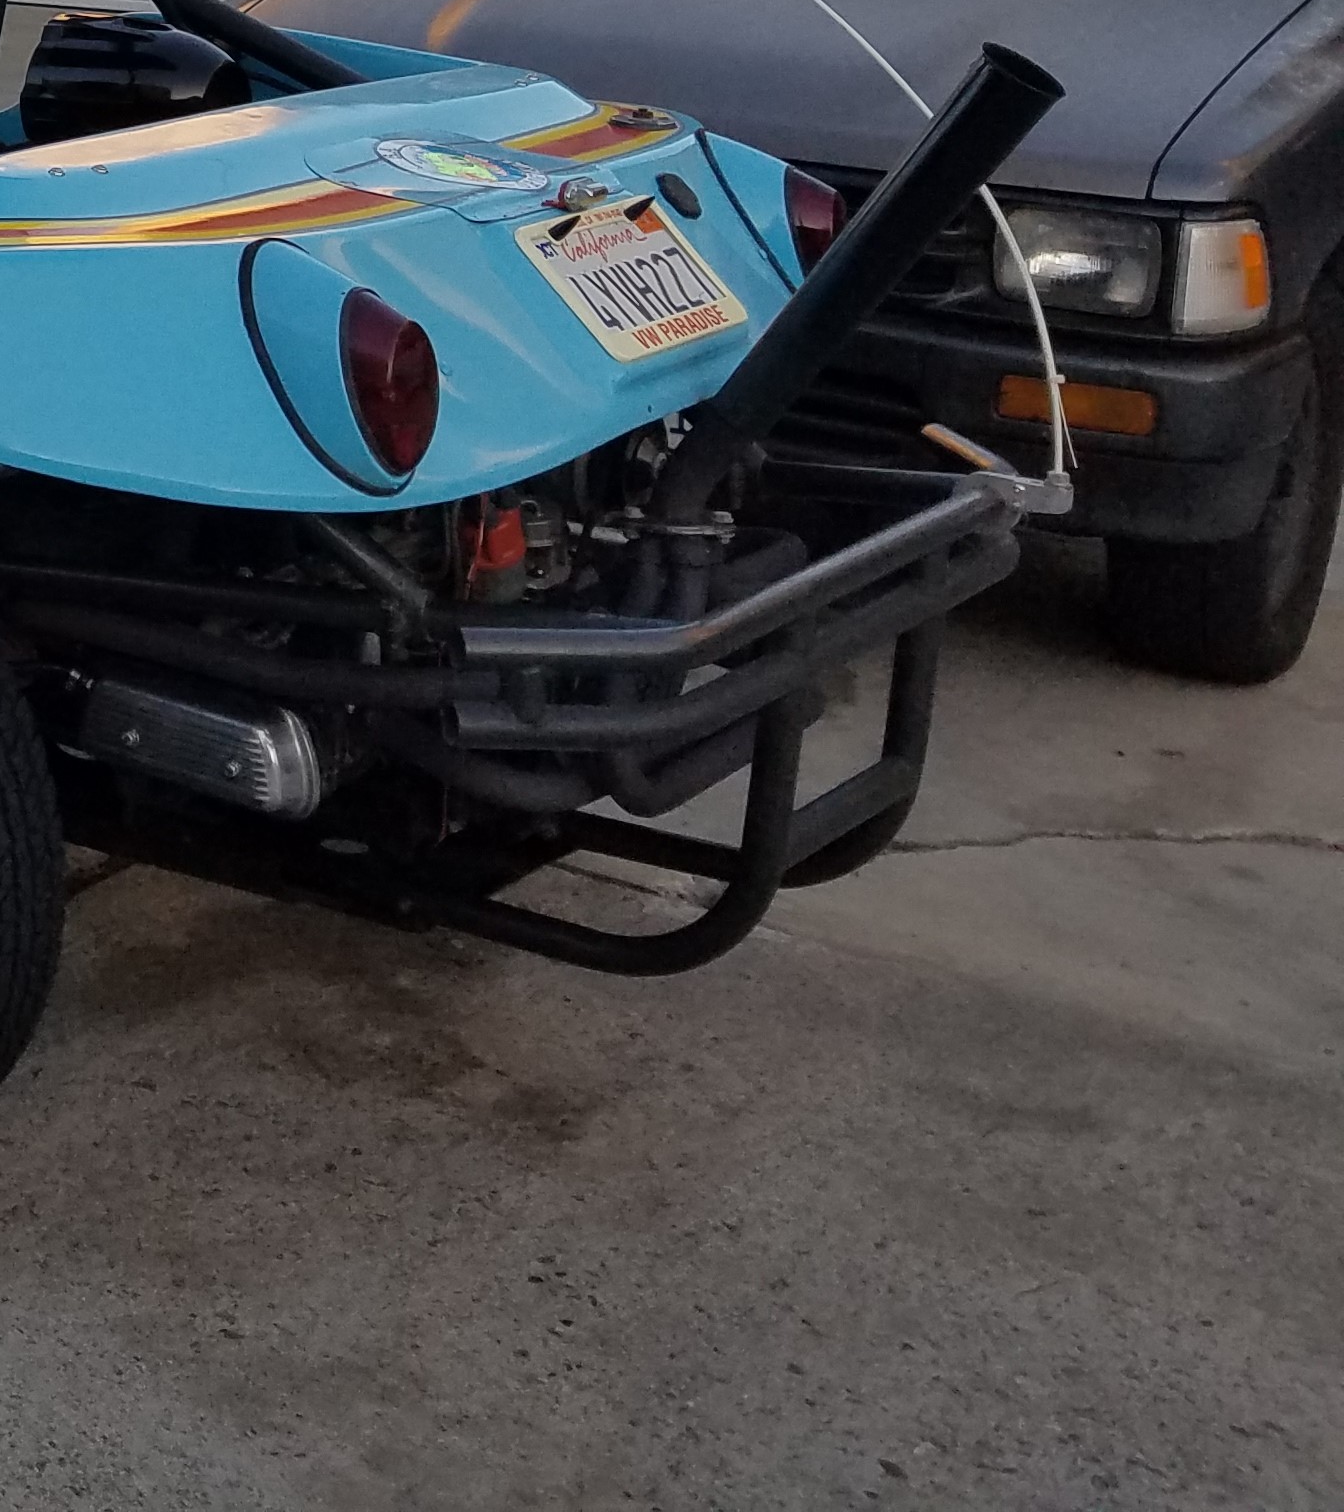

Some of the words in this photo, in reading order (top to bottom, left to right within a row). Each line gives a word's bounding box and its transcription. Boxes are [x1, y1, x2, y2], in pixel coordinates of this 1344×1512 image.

[562, 227, 647, 263] California
[632, 331, 662, 349] VW
[662, 305, 729, 342] PARADISE
